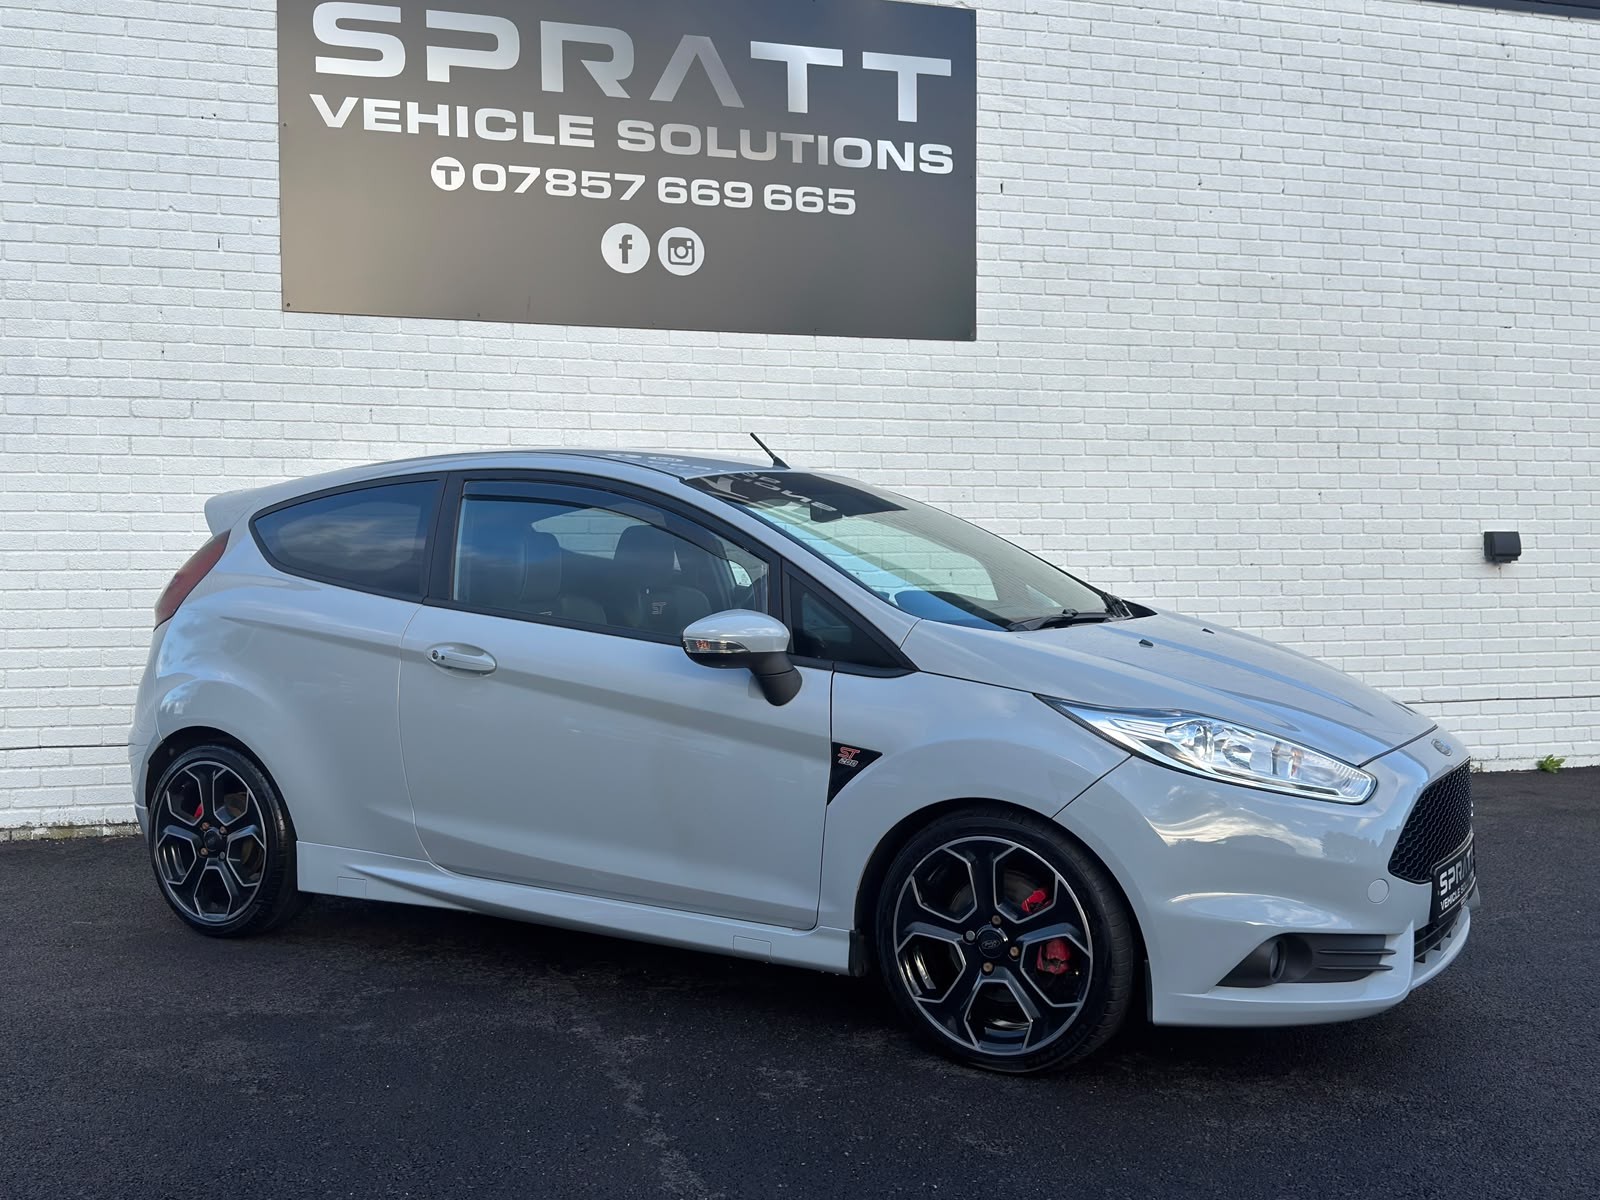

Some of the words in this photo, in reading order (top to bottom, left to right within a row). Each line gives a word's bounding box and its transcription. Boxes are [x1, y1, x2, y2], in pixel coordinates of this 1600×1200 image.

[312, 1, 951, 122] SPRATT
[309, 93, 594, 148] VEHICLE
[616, 119, 954, 175] SOLUTIONS
[472, 163, 646, 201] 07857
[656, 176, 754, 208] 669
[763, 185, 856, 215] 665
[837, 747, 860, 760] ST
[1440, 887, 1461, 911] VEHICLE
